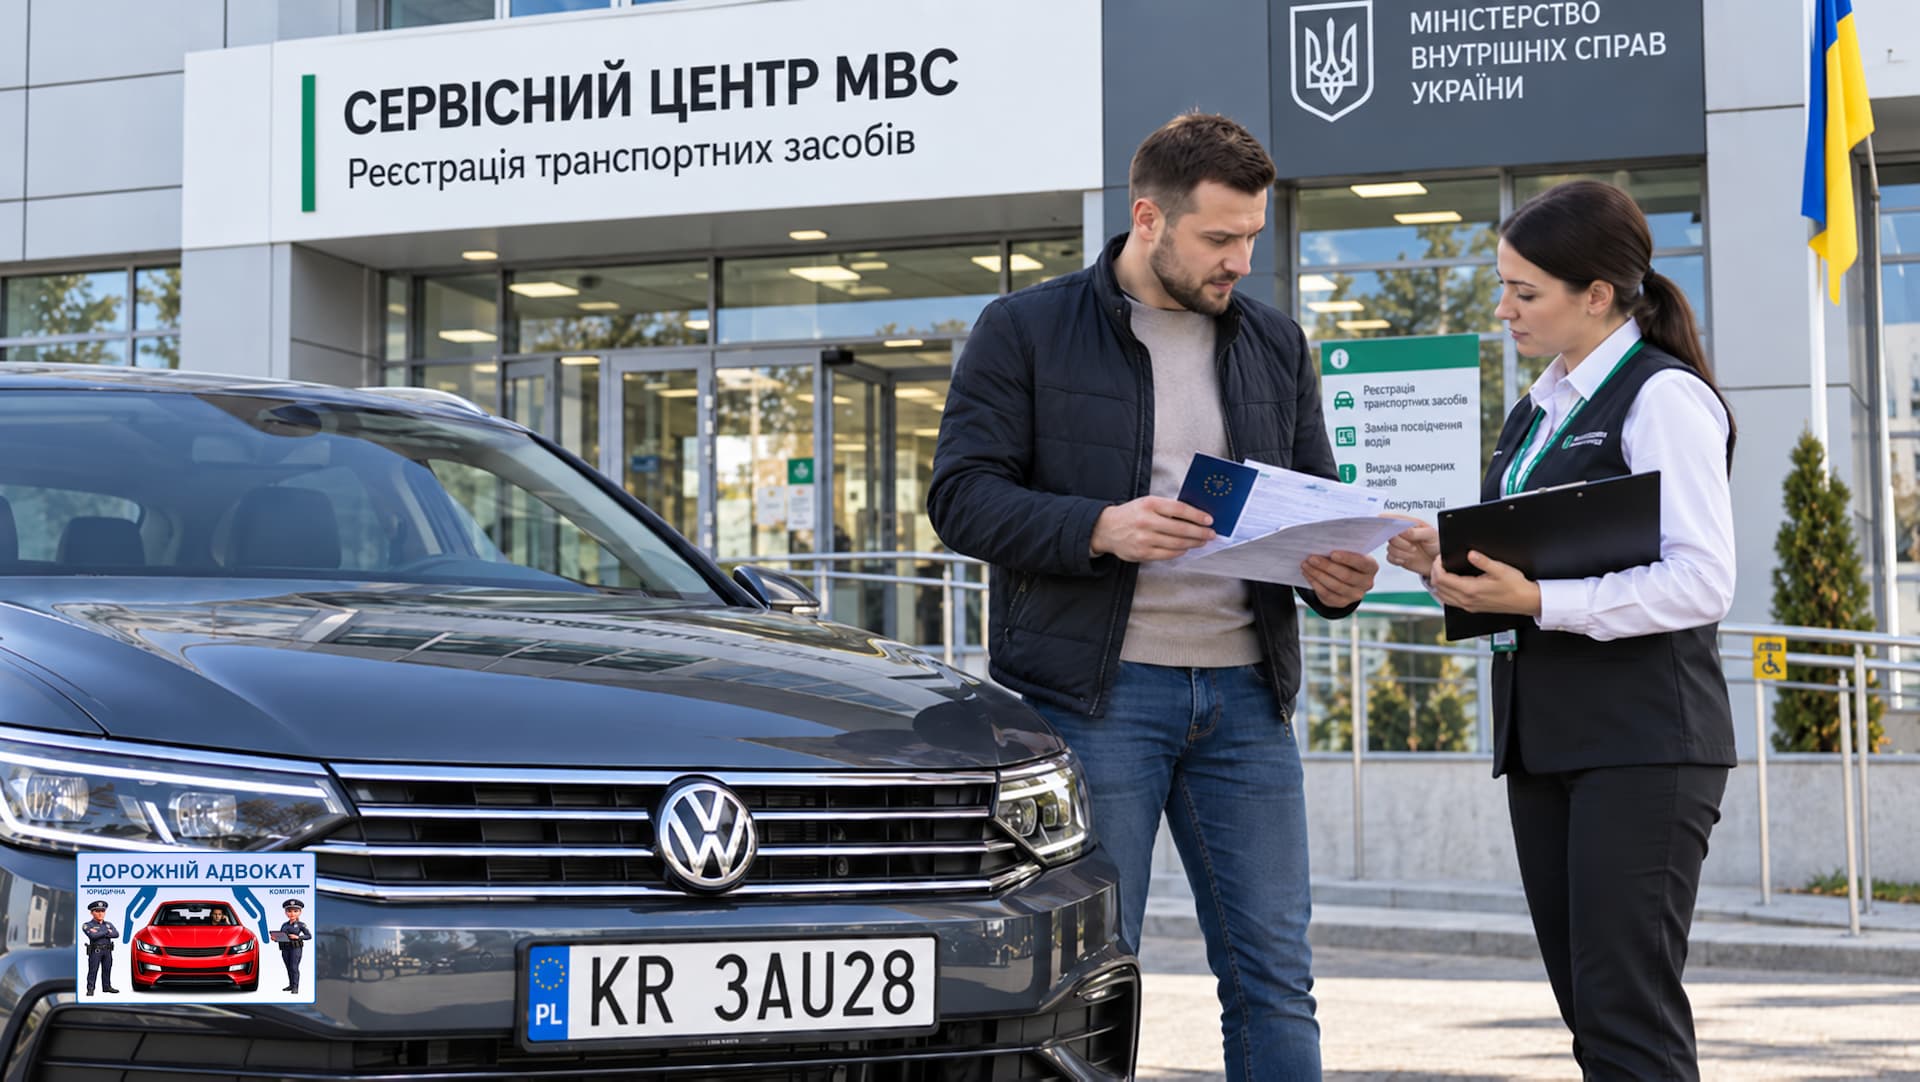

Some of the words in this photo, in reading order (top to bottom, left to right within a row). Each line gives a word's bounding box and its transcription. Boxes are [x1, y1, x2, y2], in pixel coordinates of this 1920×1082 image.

[1410, 0, 1601, 35] МІНІСТЕРСТВО
[1411, 37, 1567, 70] ВНУТРІШНІХ
[1574, 31, 1667, 60] СПРАВ
[344, 58, 631, 136] СЕРВІСНИЙ
[650, 58, 820, 123] ЦЕНТР
[836, 47, 959, 103] МВС
[1411, 72, 1523, 105] УКРАЇНИ
[349, 148, 525, 191] Реєстрація
[535, 139, 773, 184] транспортних
[784, 124, 915, 162] засобів
[1363, 397, 1430, 411] транспортних
[1431, 393, 1468, 406] засобів
[1364, 421, 1398, 434] Заміна
[1400, 420, 1463, 433] посвідчення
[1364, 435, 1391, 448] водія
[1365, 462, 1402, 474] Видача
[1404, 462, 1456, 474] номерних
[1365, 475, 1397, 488] знаків
[590, 955, 674, 1027] KR
[714, 949, 915, 1022] 3AU28
[535, 1003, 563, 1026] PL
